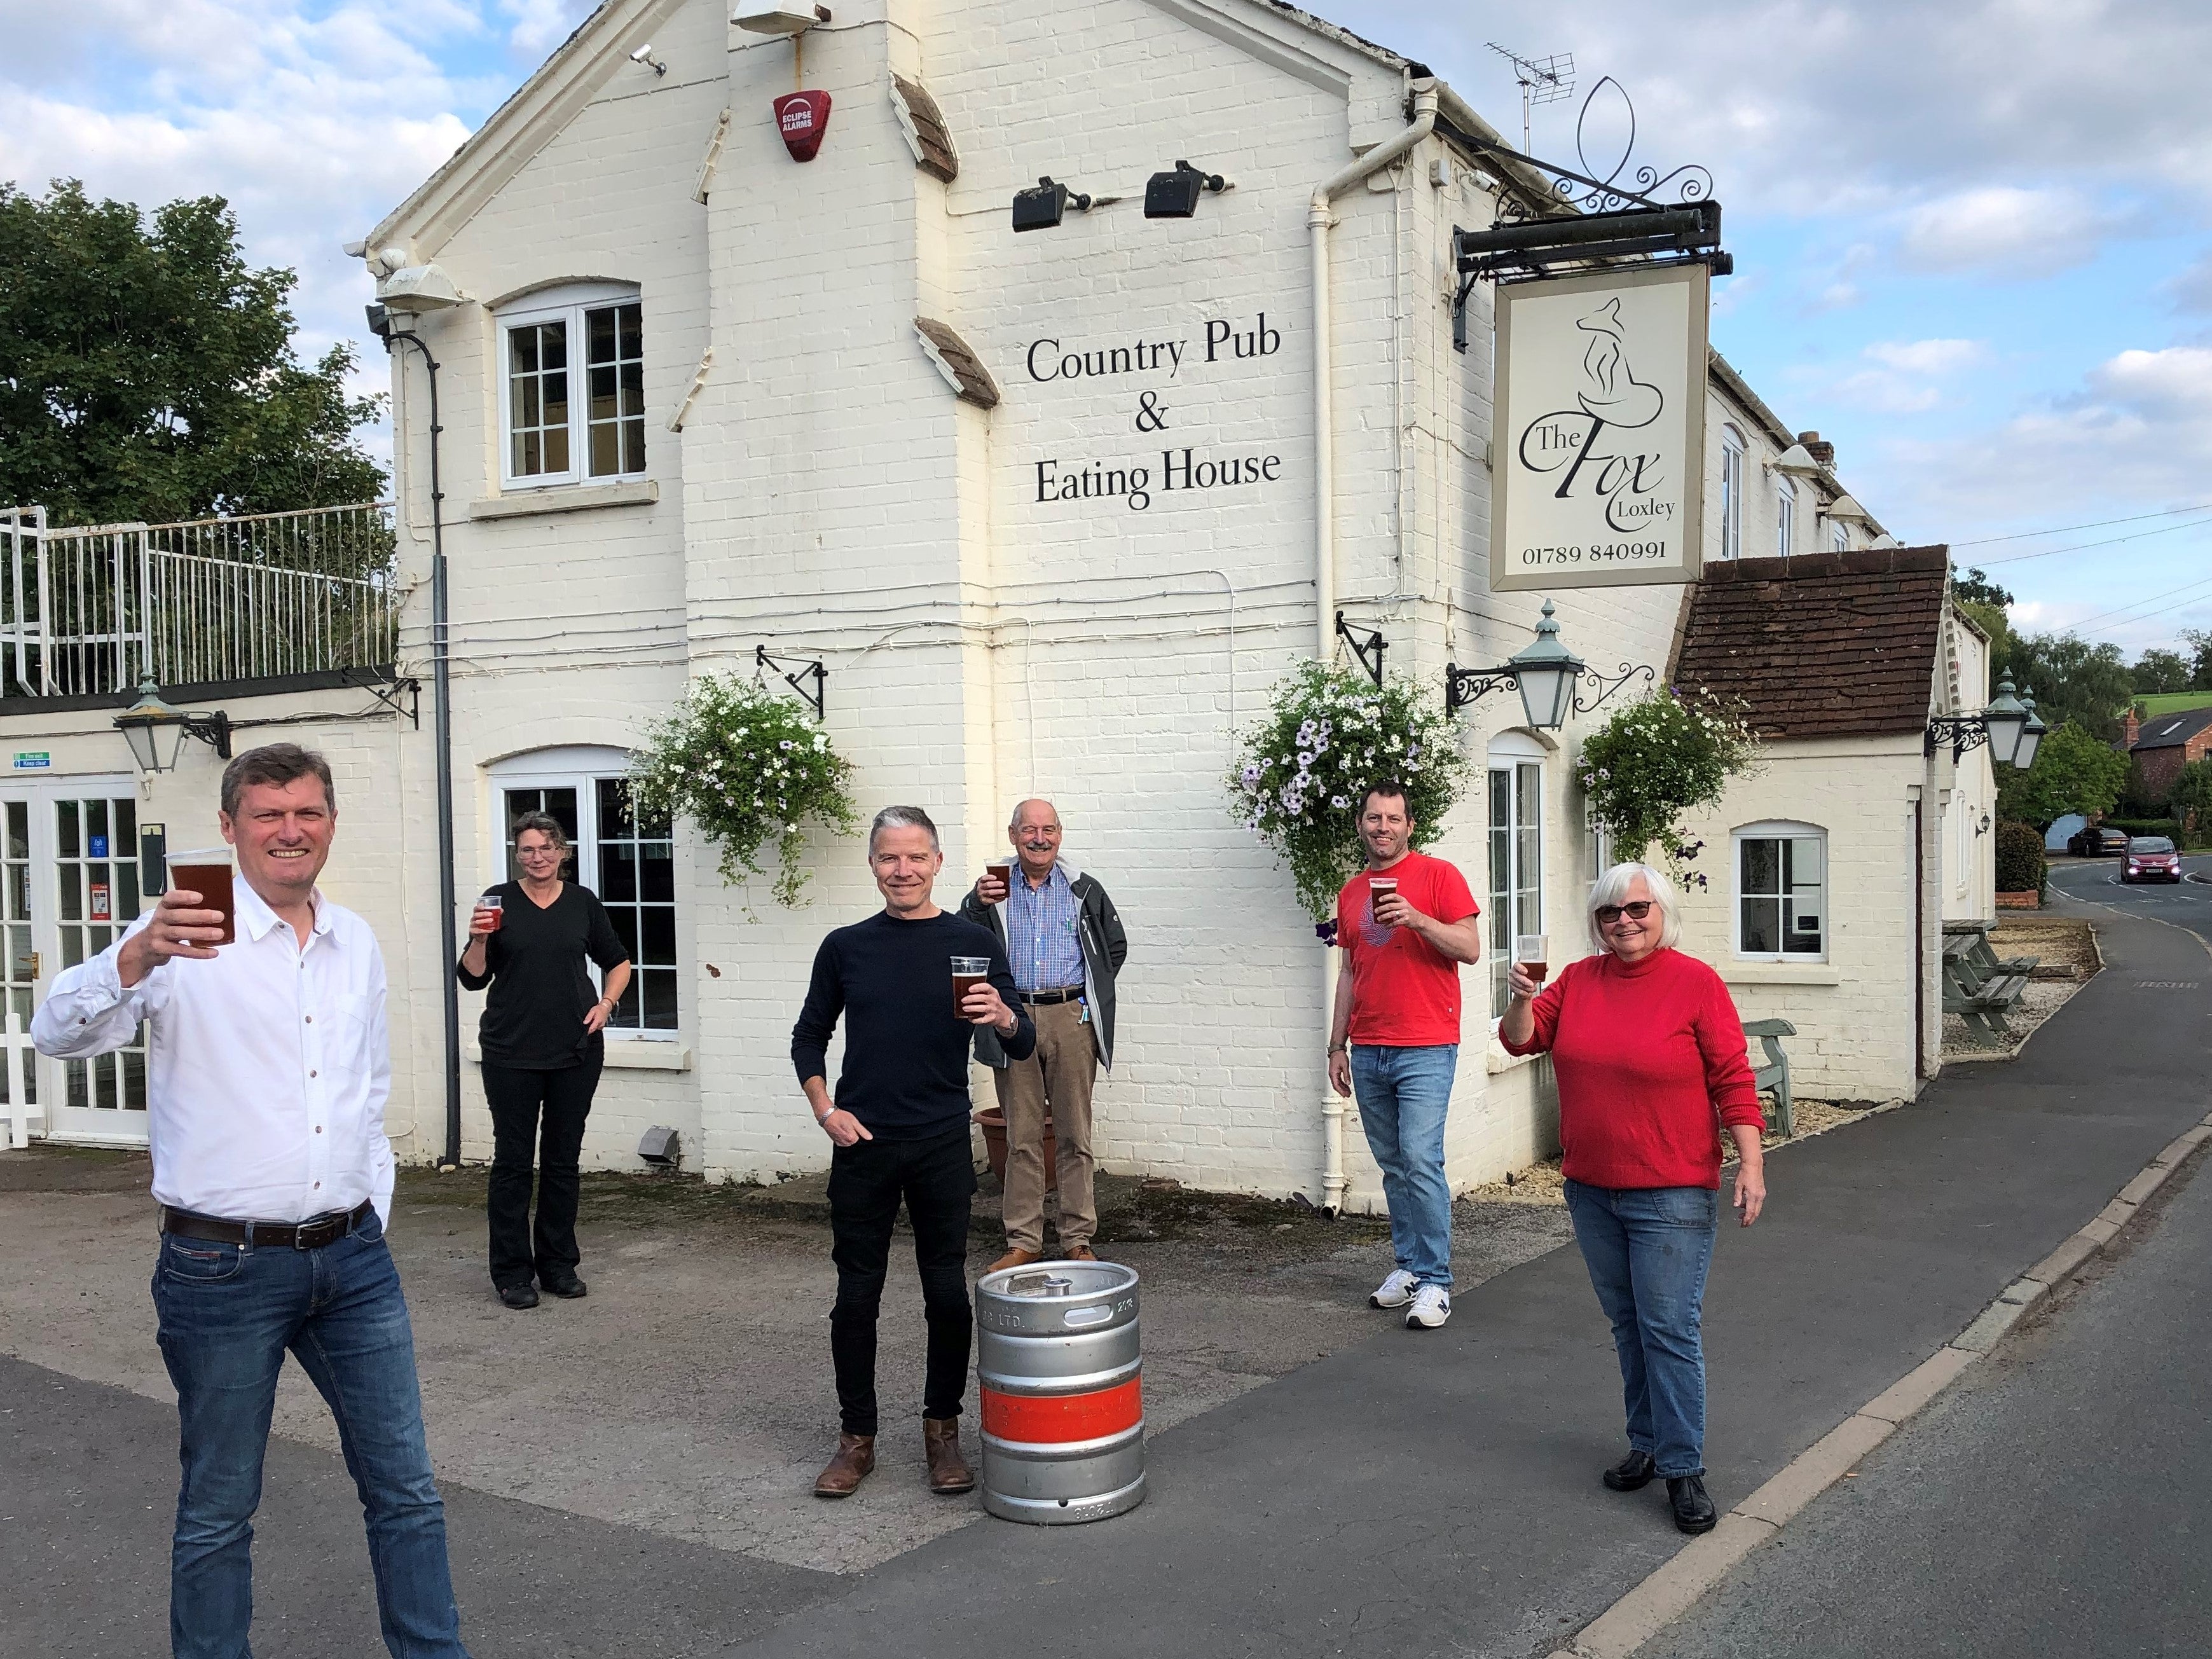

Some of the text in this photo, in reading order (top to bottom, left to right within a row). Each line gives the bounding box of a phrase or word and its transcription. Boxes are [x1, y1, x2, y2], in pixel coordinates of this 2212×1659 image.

[783, 111, 812, 123] ECLIPSE
[783, 119, 813, 132] ALARMS
[1027, 312, 1281, 382] Country Pub
[1135, 390, 1170, 432] &
[1535, 424, 1581, 450] The
[1519, 411, 1665, 499] Fox
[1034, 448, 1282, 511] Eating House
[1616, 497, 1675, 521] Loxley
[1522, 540, 1666, 565] 01789 840991
